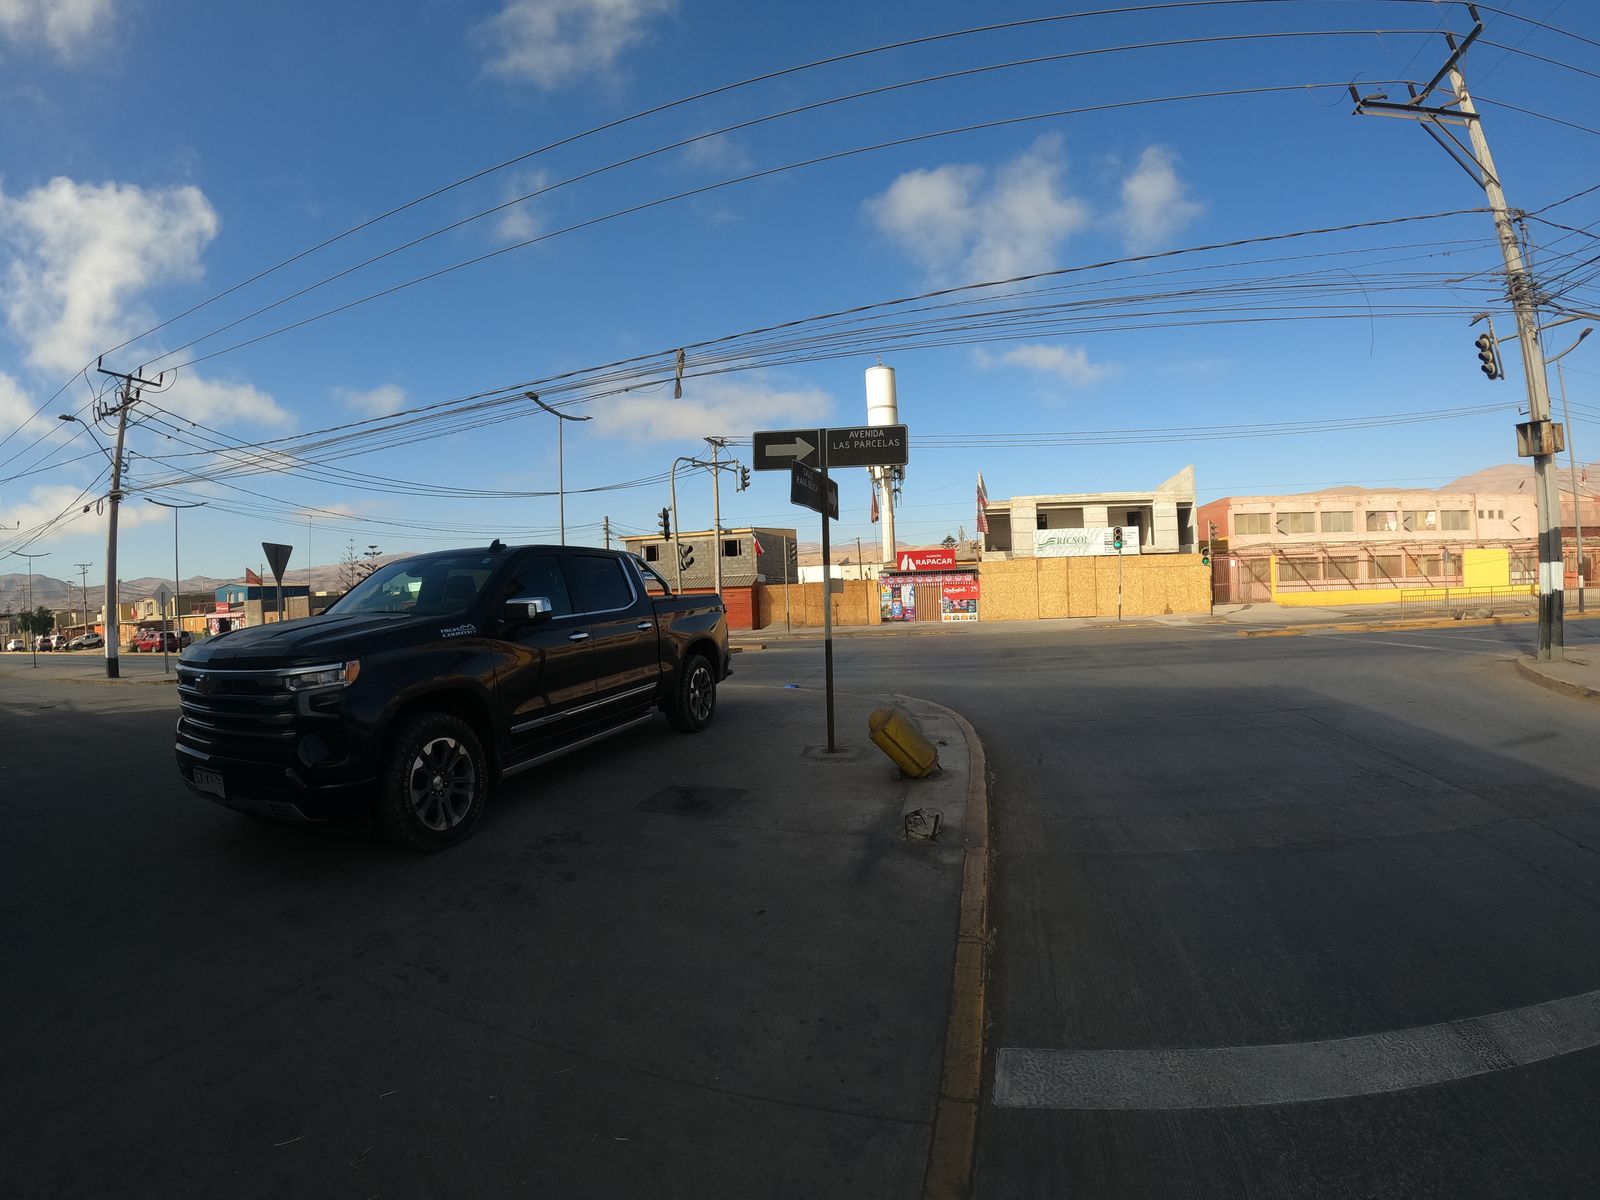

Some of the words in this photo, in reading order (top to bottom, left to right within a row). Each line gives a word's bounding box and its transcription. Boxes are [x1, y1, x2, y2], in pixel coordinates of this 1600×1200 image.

[849, 429, 885, 438] AVENIDA
[833, 441, 850, 450] LAS
[854, 438, 900, 449] PARCELAS
[915, 558, 953, 566] RAPACAR
